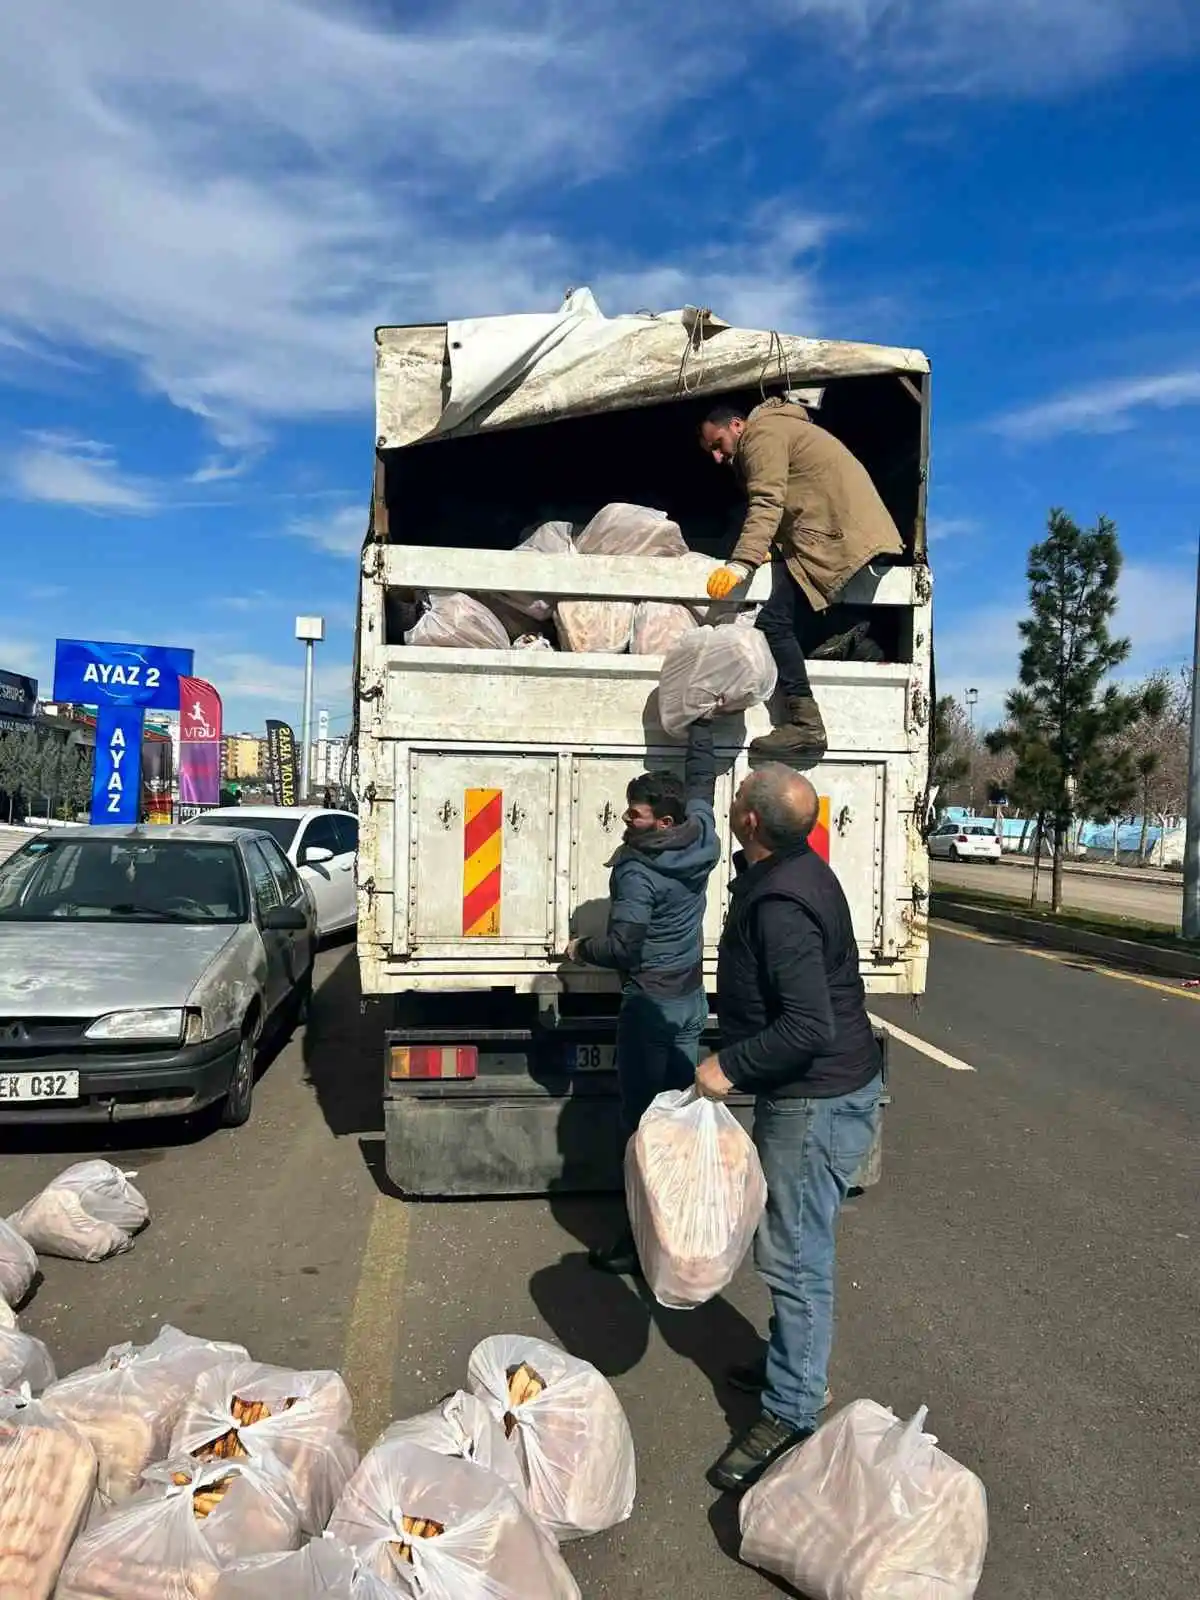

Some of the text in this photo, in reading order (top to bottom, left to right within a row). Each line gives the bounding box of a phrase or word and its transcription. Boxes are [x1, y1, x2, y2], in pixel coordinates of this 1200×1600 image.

[83, 663, 161, 688] AYAZ 2
[107, 727, 125, 813] AYAZ
[579, 1046, 601, 1068] 38
[31, 1075, 67, 1097] 032
